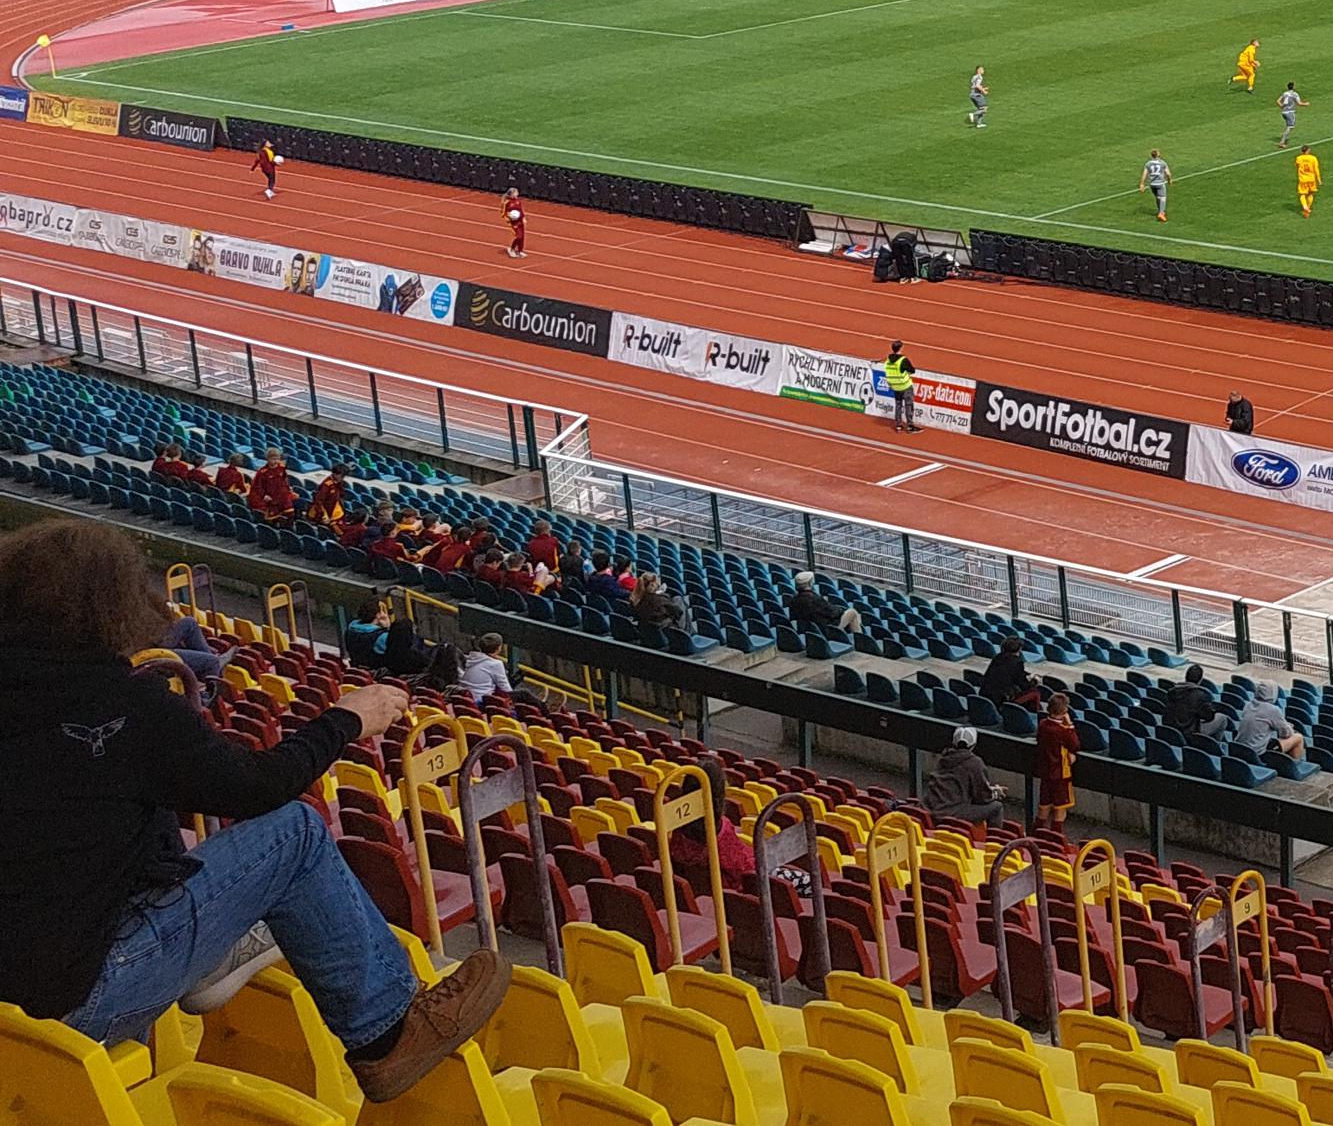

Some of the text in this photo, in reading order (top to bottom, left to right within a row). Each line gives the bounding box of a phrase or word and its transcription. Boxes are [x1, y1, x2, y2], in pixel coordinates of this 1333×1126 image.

[143, 114, 207, 144] Carbounion
[219, 249, 249, 271] BRAVO
[492, 300, 596, 346] Carbounion
[622, 324, 681, 359] R-built
[705, 340, 770, 376] R-built
[823, 359, 868, 381] INTERNET
[803, 373, 844, 394] MODERNÍ
[844, 381, 857, 396] TV
[985, 389, 1172, 459] SportFotbal.cz
[1087, 445, 1128, 464] FOTBALOVÝ
[1243, 454, 1289, 485] Ford
[427, 755, 444, 772] 13
[675, 802, 691, 820] 12
[887, 846, 897, 860] 11
[1089, 873, 1102, 886] 10
[1244, 902, 1251, 914] 9
